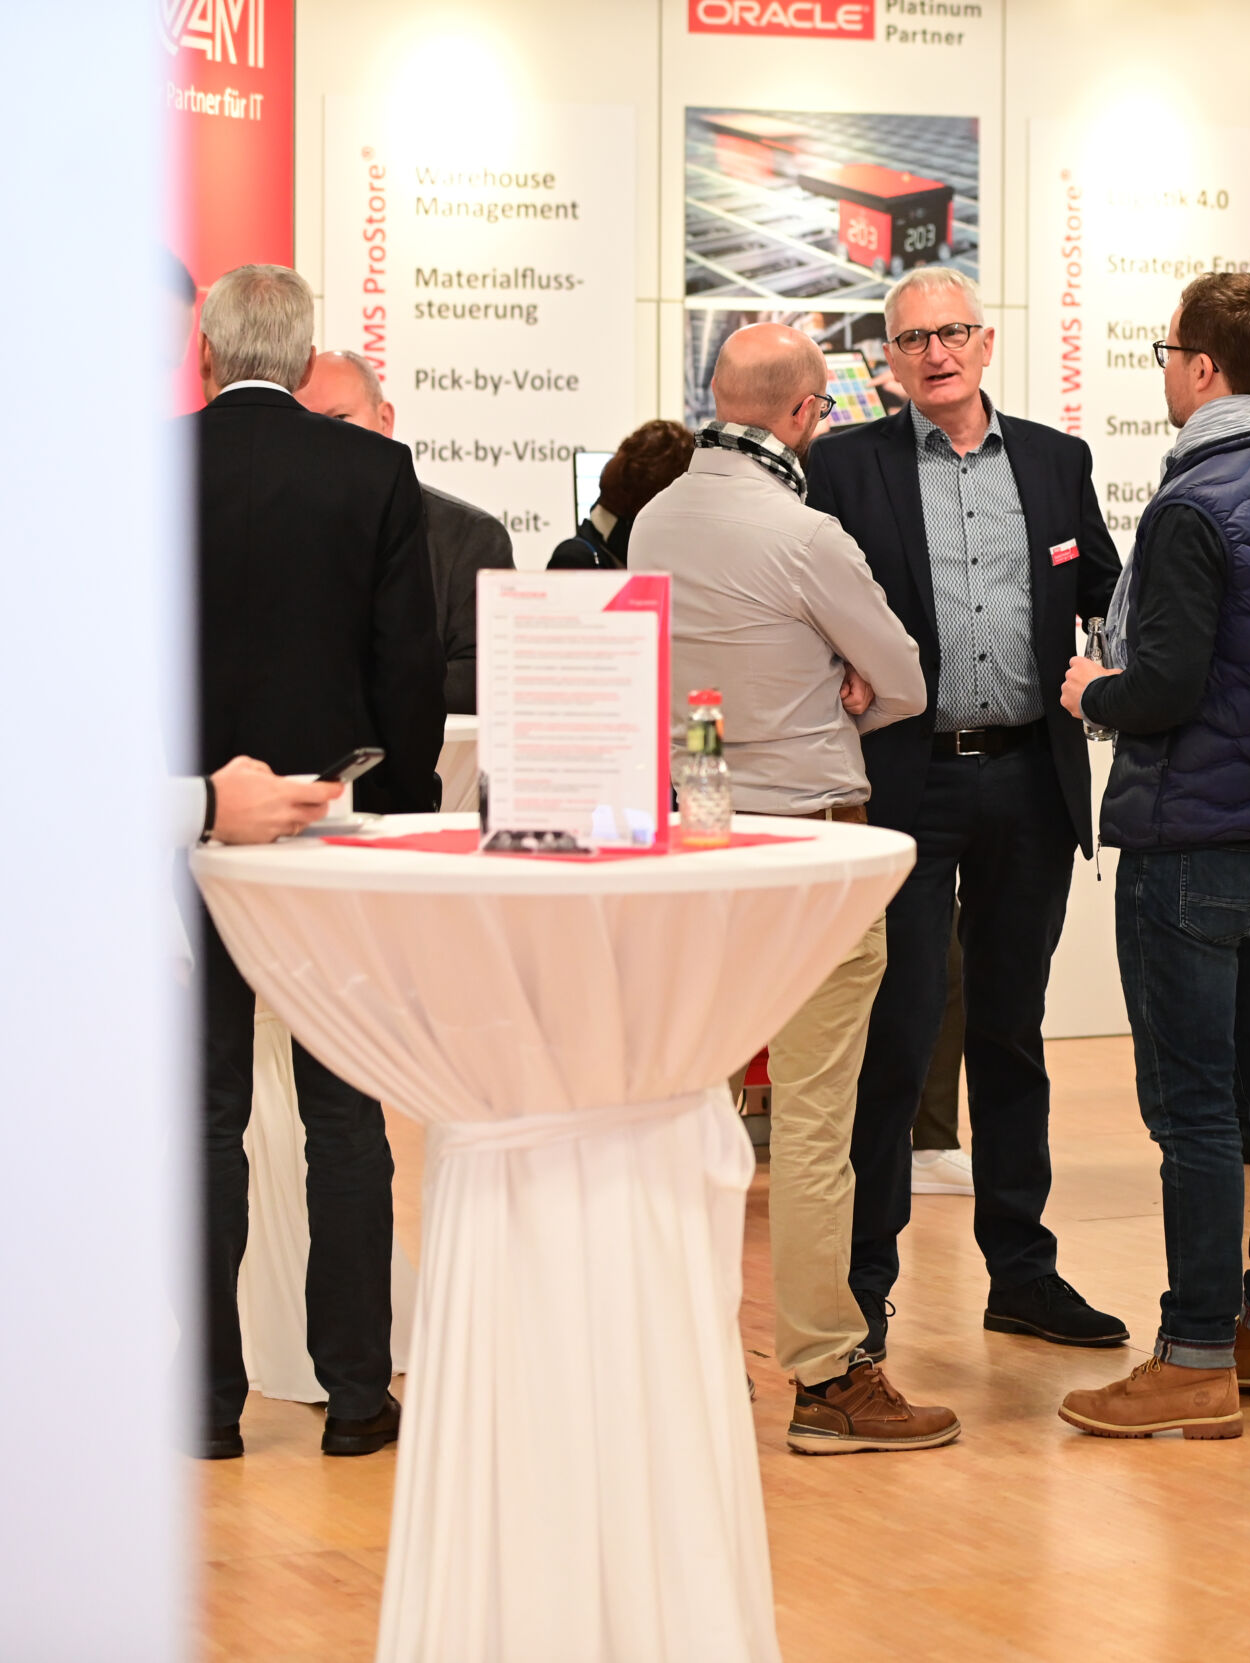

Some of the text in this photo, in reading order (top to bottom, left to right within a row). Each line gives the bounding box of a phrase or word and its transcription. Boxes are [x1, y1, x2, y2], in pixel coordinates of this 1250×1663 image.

[697, 0, 863, 31] ORACLE
[885, 0, 982, 18] Platinum
[885, 25, 965, 46] Partner
[223, 86, 247, 118] für
[249, 93, 264, 120] IT
[415, 166, 556, 190] Warehouse
[415, 197, 580, 224] Management
[1196, 189, 1230, 210] 4.0
[415, 267, 585, 291] Materialfluss-
[1107, 254, 1205, 280] Strategie
[415, 300, 539, 325] steuerung
[1061, 318, 1083, 395] WMS
[415, 368, 580, 395] Pick-by-Voice
[1106, 416, 1171, 437] Smart
